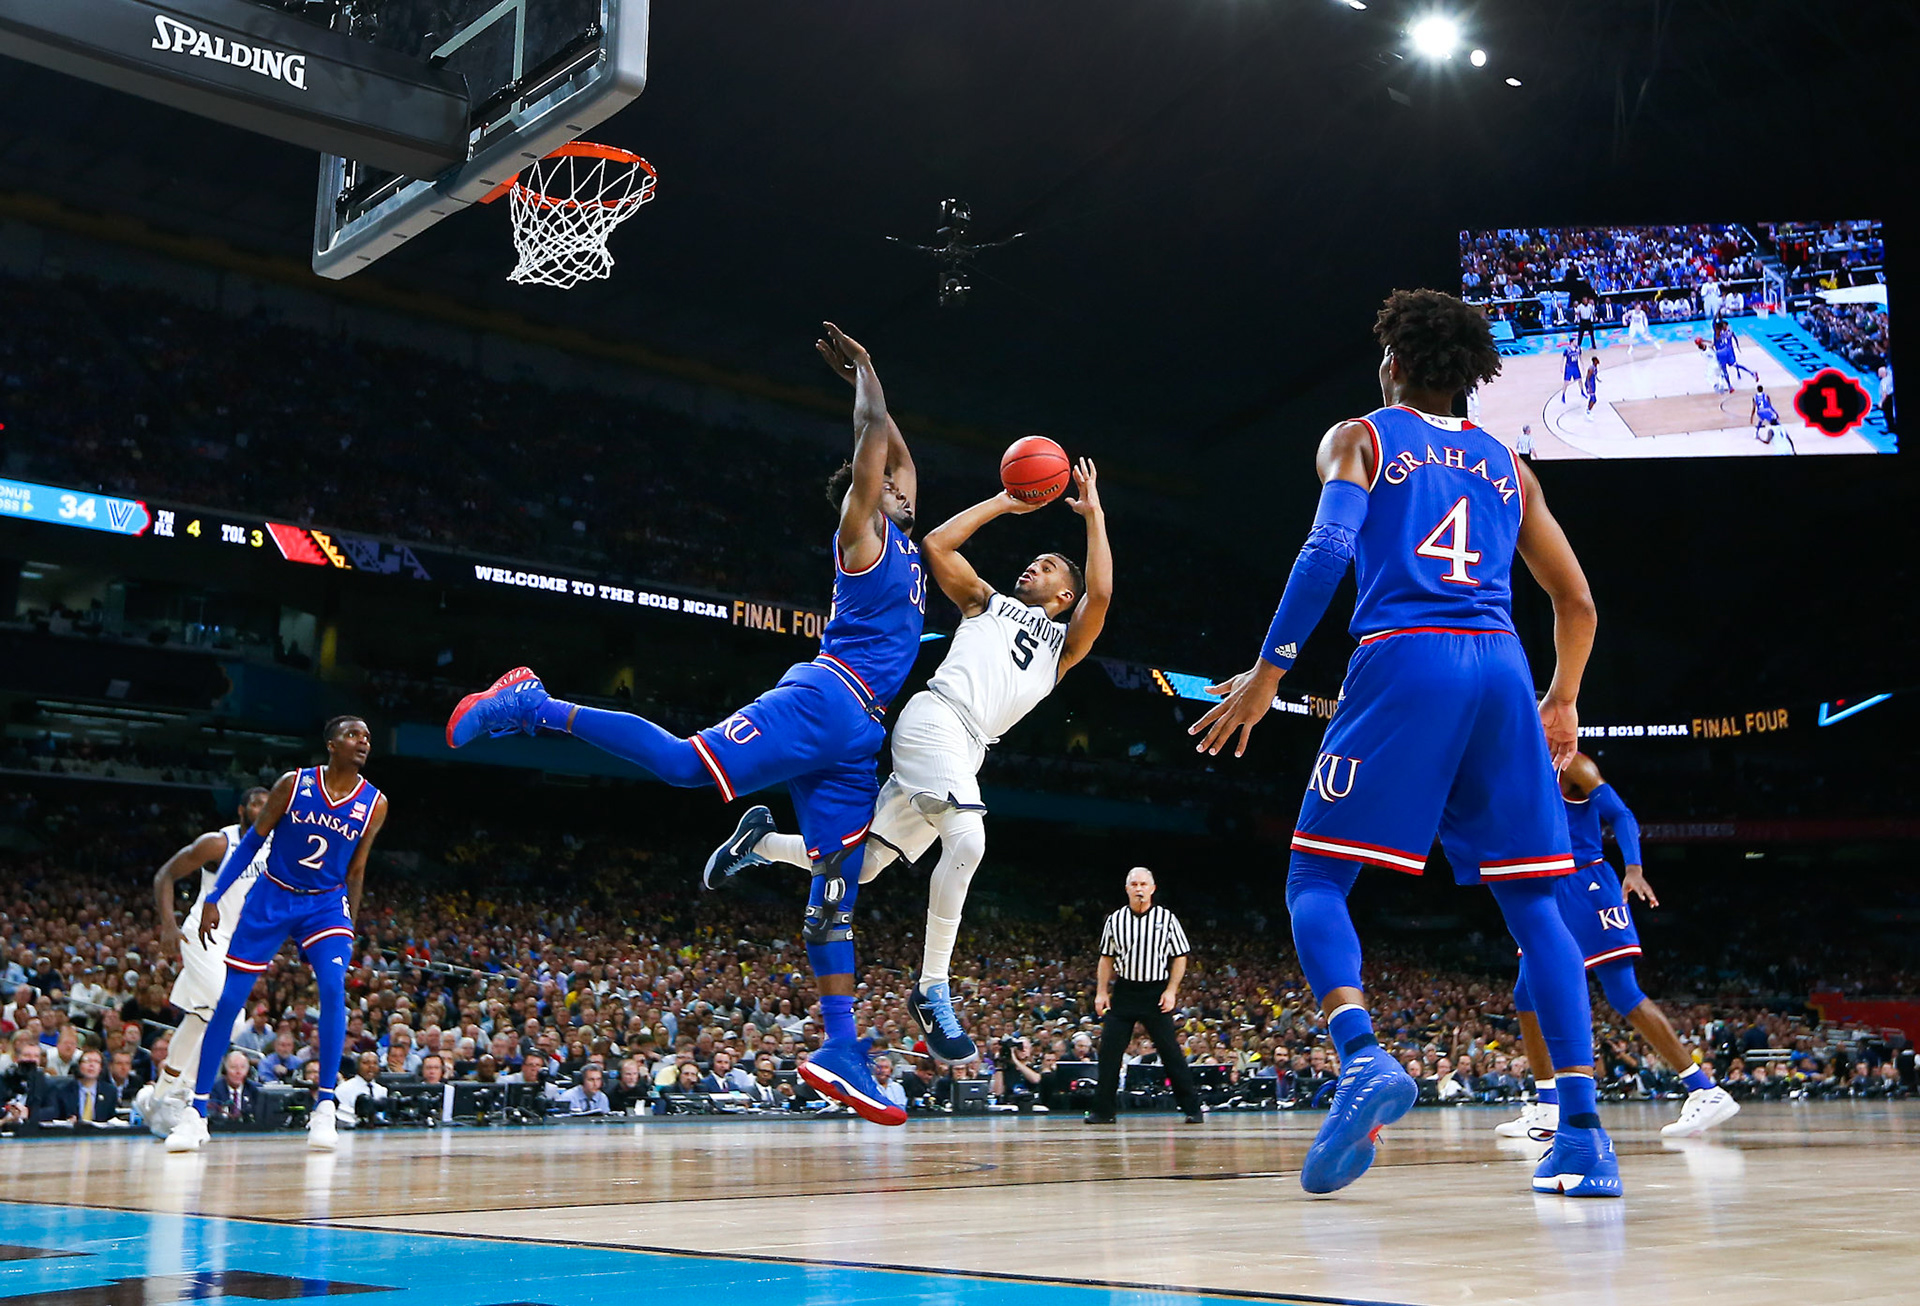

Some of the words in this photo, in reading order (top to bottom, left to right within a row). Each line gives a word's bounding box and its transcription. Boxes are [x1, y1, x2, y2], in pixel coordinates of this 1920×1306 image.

[152, 14, 306, 91] SPALDING
[1766, 333, 1831, 373] NCAA
[1820, 387, 1843, 418] 1
[1014, 483, 1060, 499] Wilson
[1384, 444, 1517, 505] GRAHAM
[0, 485, 31, 501] ONUS
[58, 494, 97, 522] 34
[187, 519, 201, 538] 4
[221, 524, 246, 545] TOL
[250, 529, 263, 547] 3
[1415, 496, 1481, 586] 4
[474, 565, 568, 593] WELCOME
[571, 580, 595, 597] TO
[599, 585, 635, 604] THE
[638, 592, 679, 611] 2018
[682, 599, 729, 619] NCAA
[732, 600, 786, 634] FINAL
[792, 610, 828, 640] FOU
[998, 601, 1064, 659] VILLANOVA
[1010, 628, 1039, 671] 5
[1647, 724, 1689, 737] NCAA
[1692, 717, 1741, 739] FINAL
[1745, 707, 1789, 734] FOUR
[1308, 752, 1362, 802] KU
[290, 810, 360, 841] KANSAS
[298, 834, 329, 870] 2
[1597, 906, 1630, 931] KU
